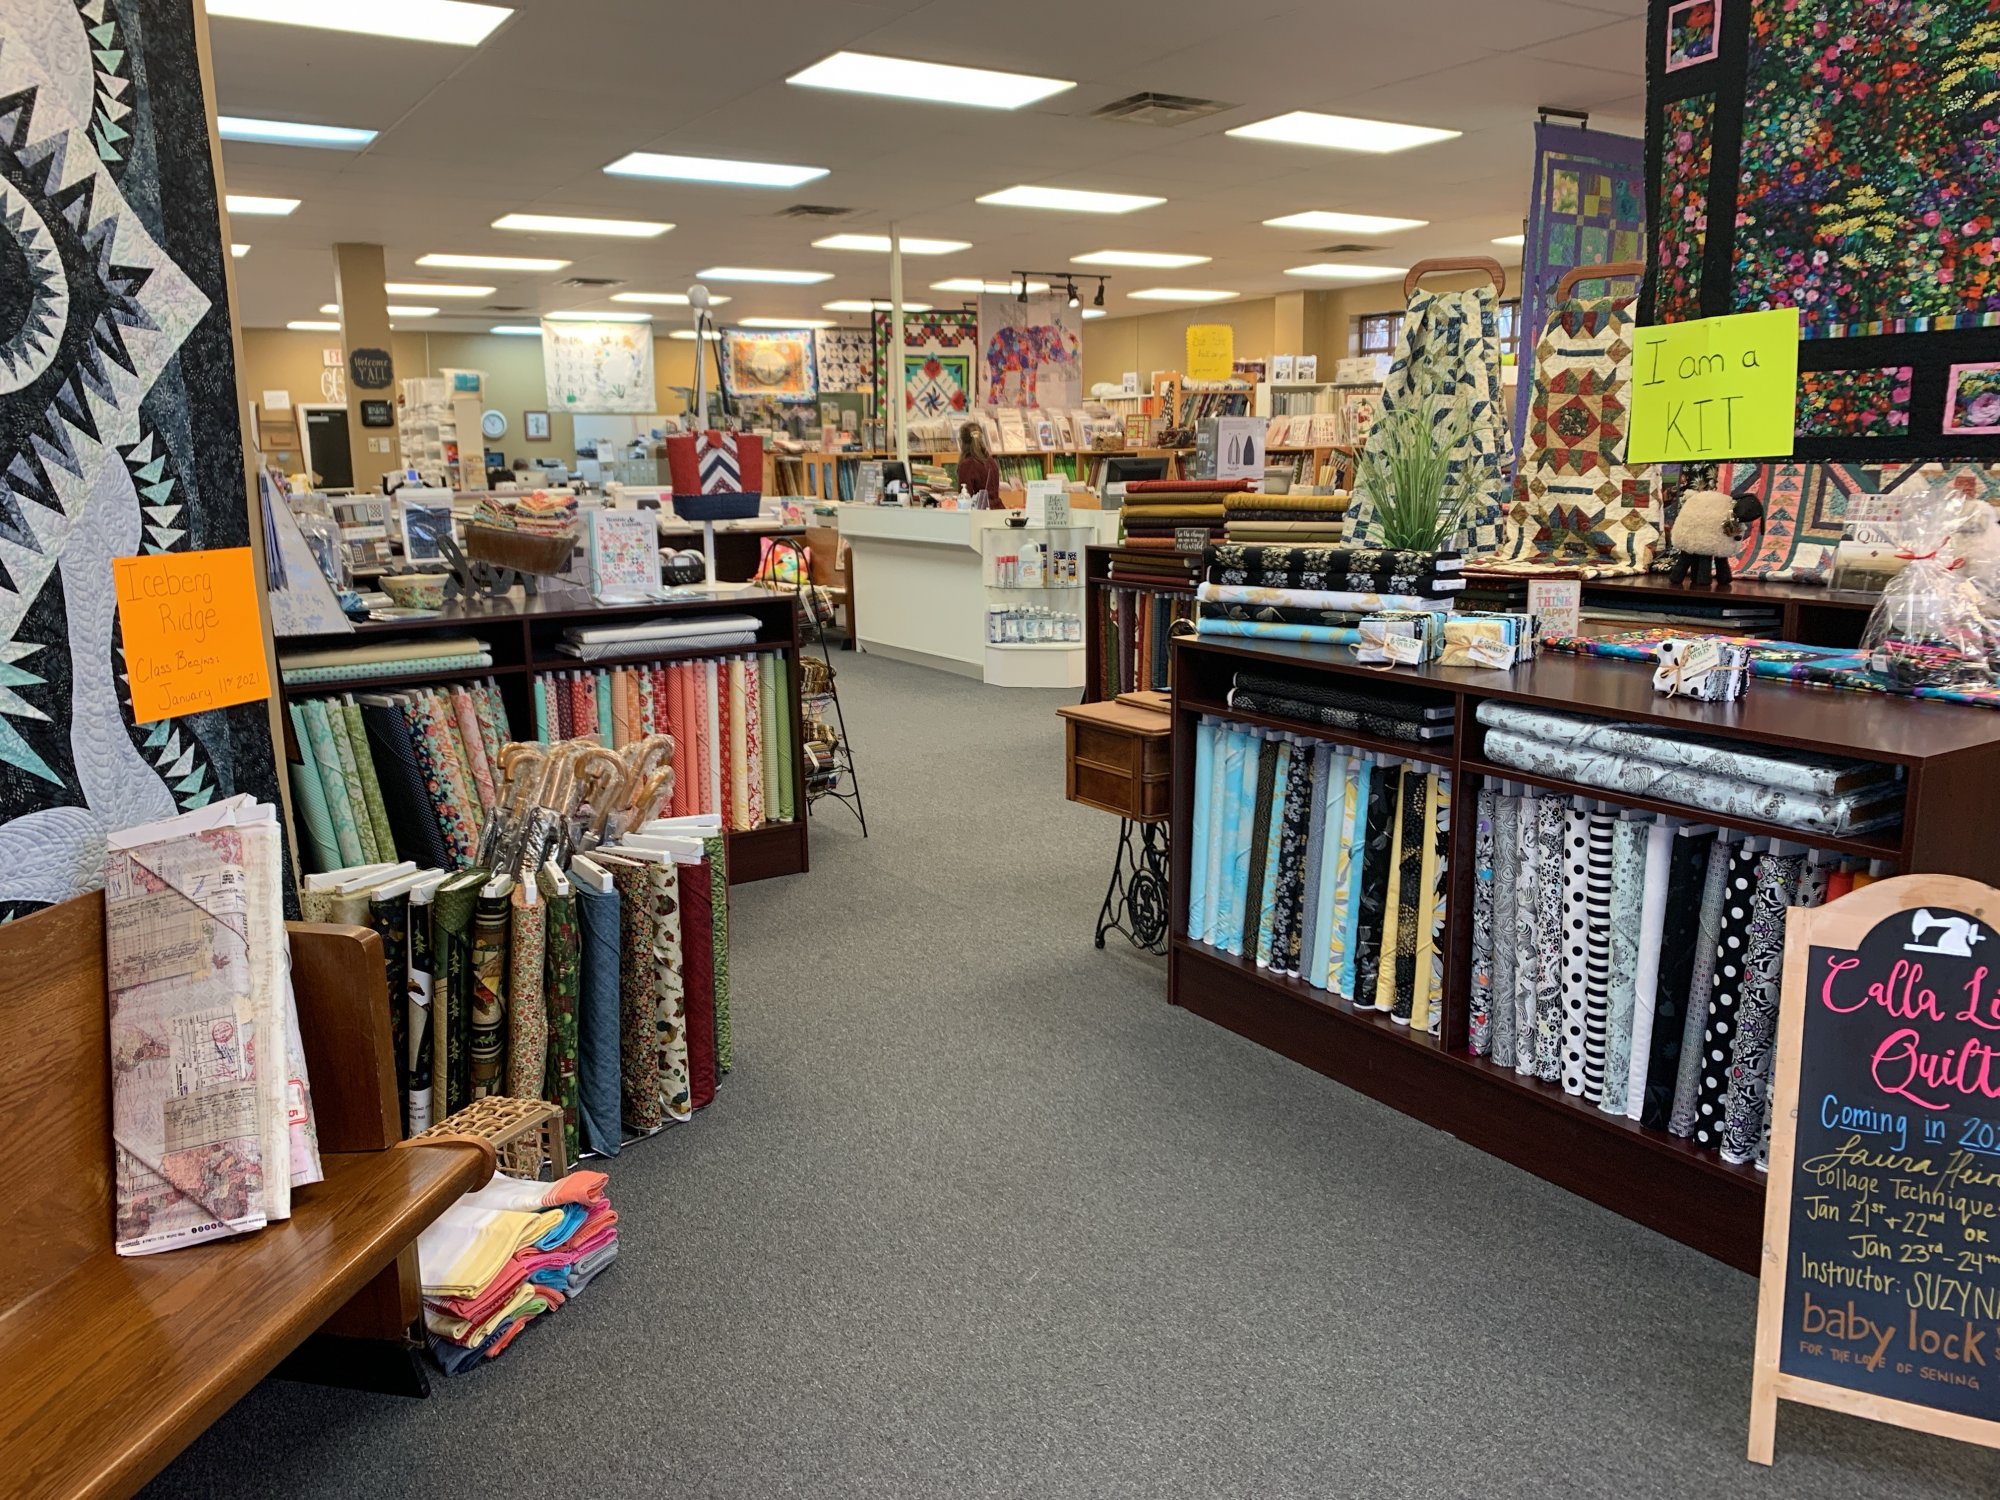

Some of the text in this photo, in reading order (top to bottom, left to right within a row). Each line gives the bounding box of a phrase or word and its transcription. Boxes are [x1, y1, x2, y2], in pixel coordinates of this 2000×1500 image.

[354, 357, 388, 367] Welcome
[1642, 339, 1760, 386] I am a
[1664, 396, 1744, 454] KIT
[120, 563, 213, 604] Iceberg
[1536, 596, 1573, 607] THINK
[158, 603, 220, 644] Ridge
[1536, 607, 1573, 617] HAPPY
[135, 658, 172, 684] Class
[158, 682, 213, 711] January
[1822, 955, 2000, 1030] Calla Li
[1871, 1029, 2000, 1110] Quilt
[1821, 1095, 1907, 1151] Coming
[1924, 1115, 1945, 1139] in
[1802, 1134, 1938, 1176] Laura
[1804, 1196, 1839, 1221] Jan
[1849, 1203, 1887, 1227] 21st
[1817, 1164, 2000, 1225] Collage Technique
[1848, 1235, 1891, 1260] Jan
[1900, 1243, 1943, 1263] 23rd
[1802, 1252, 1902, 1295] Instructor:
[1803, 1292, 1896, 1373] baby
[1909, 1309, 1987, 1366] lock
[1800, 1341, 1824, 1356] FOR
[1831, 1348, 1851, 1363] THE
[1896, 1362, 1913, 1375] OF
[1920, 1367, 1980, 1390] SEWING
